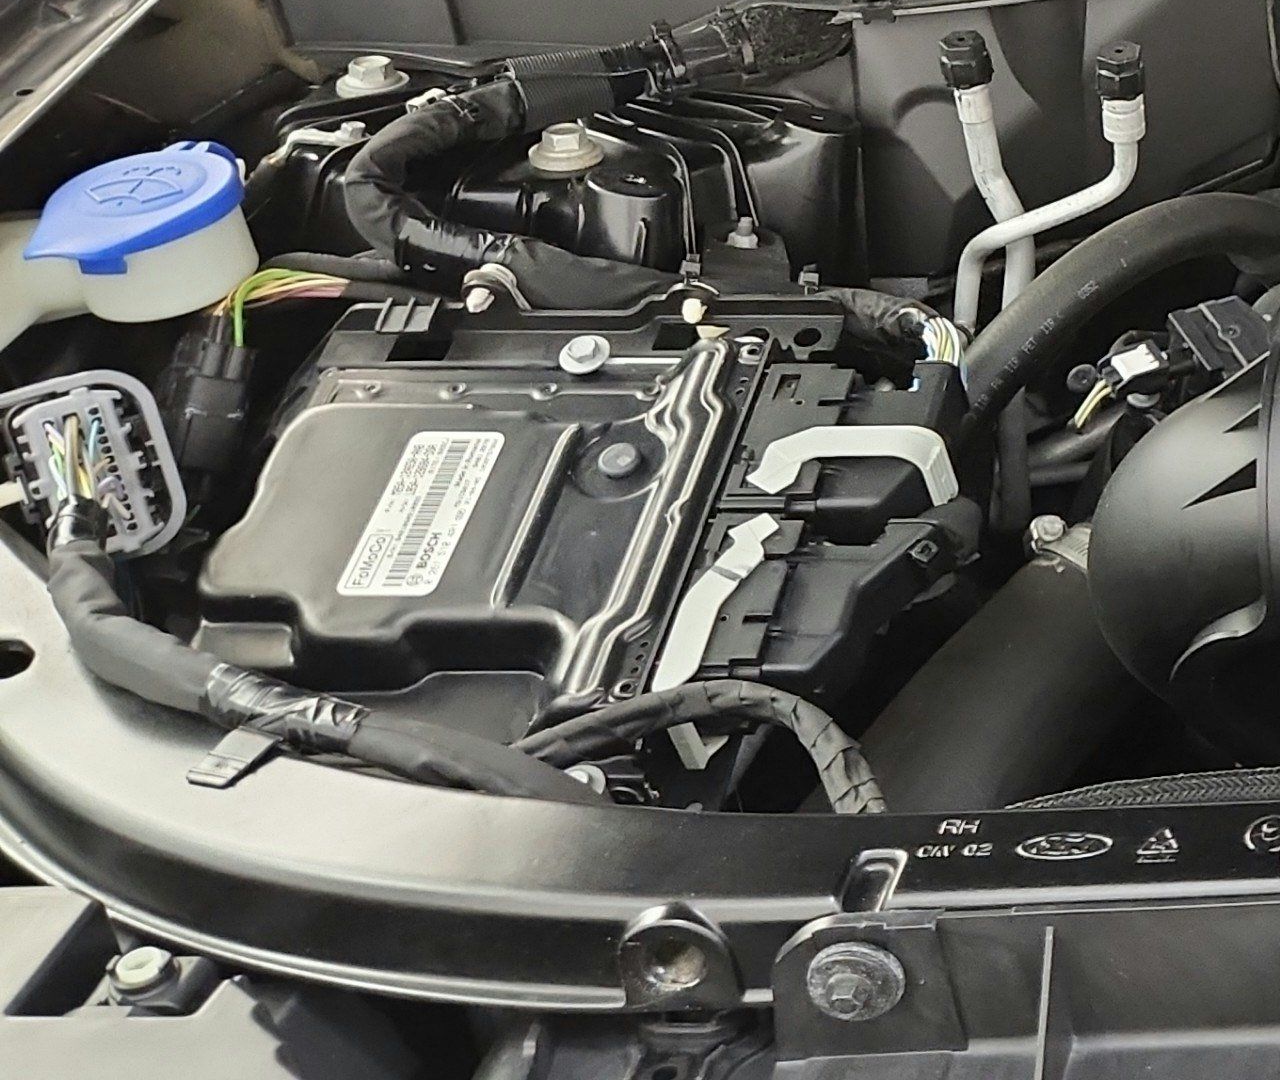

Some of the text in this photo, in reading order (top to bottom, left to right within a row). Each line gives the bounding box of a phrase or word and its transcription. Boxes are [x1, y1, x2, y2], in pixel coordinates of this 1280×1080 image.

[352, 536, 386, 586] FoMoCo
[416, 531, 442, 569] BOSCH
[937, 818, 982, 835] RH
[960, 842, 994, 857] 02
